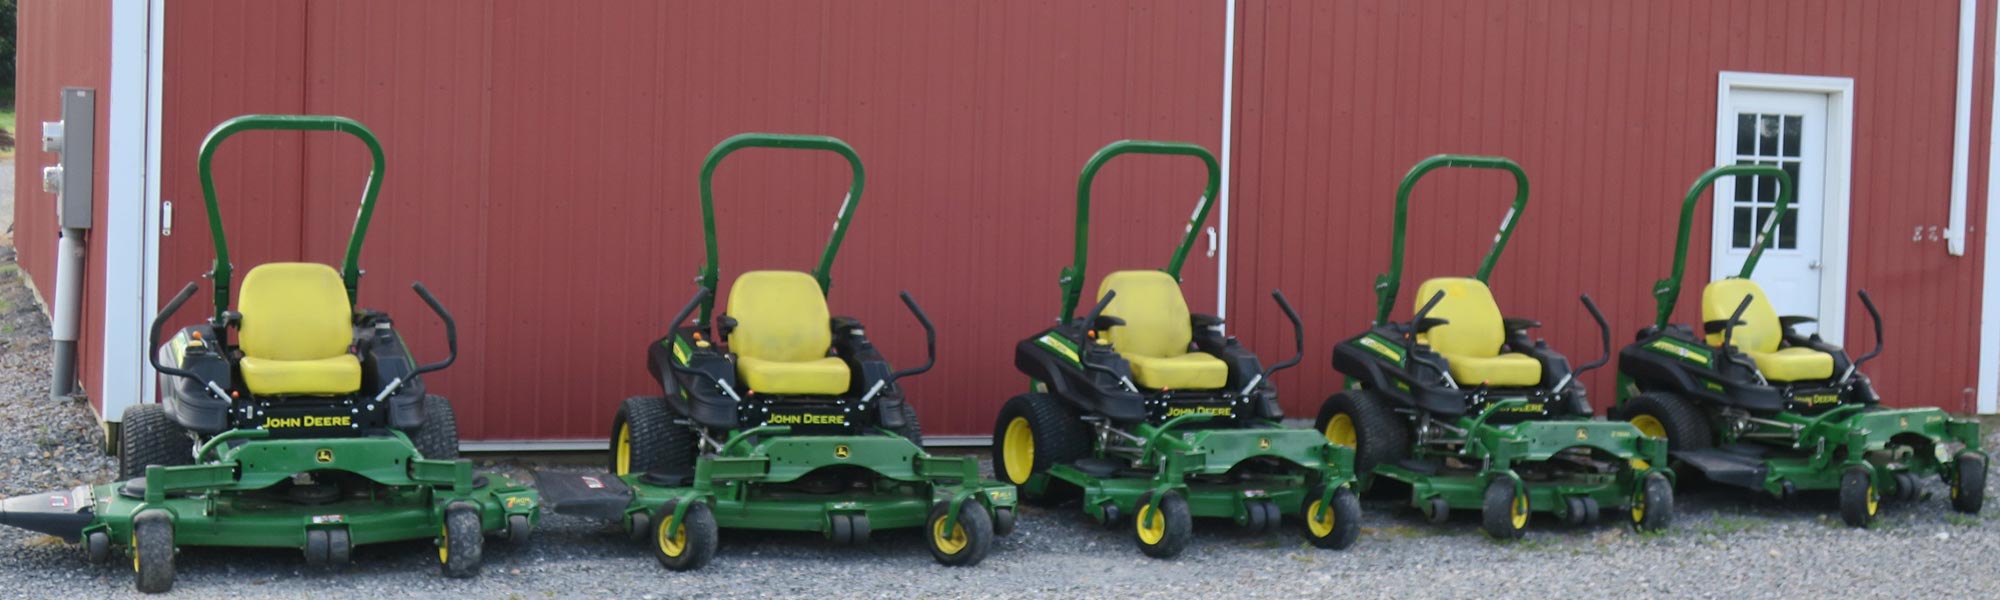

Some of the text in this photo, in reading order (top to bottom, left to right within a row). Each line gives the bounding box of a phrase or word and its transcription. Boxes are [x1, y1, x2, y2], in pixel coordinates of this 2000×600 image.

[1166, 407, 1195, 417] JOHN
[262, 415, 351, 428] JOHN DEERE
[767, 413, 845, 424] JOHN DEERE
